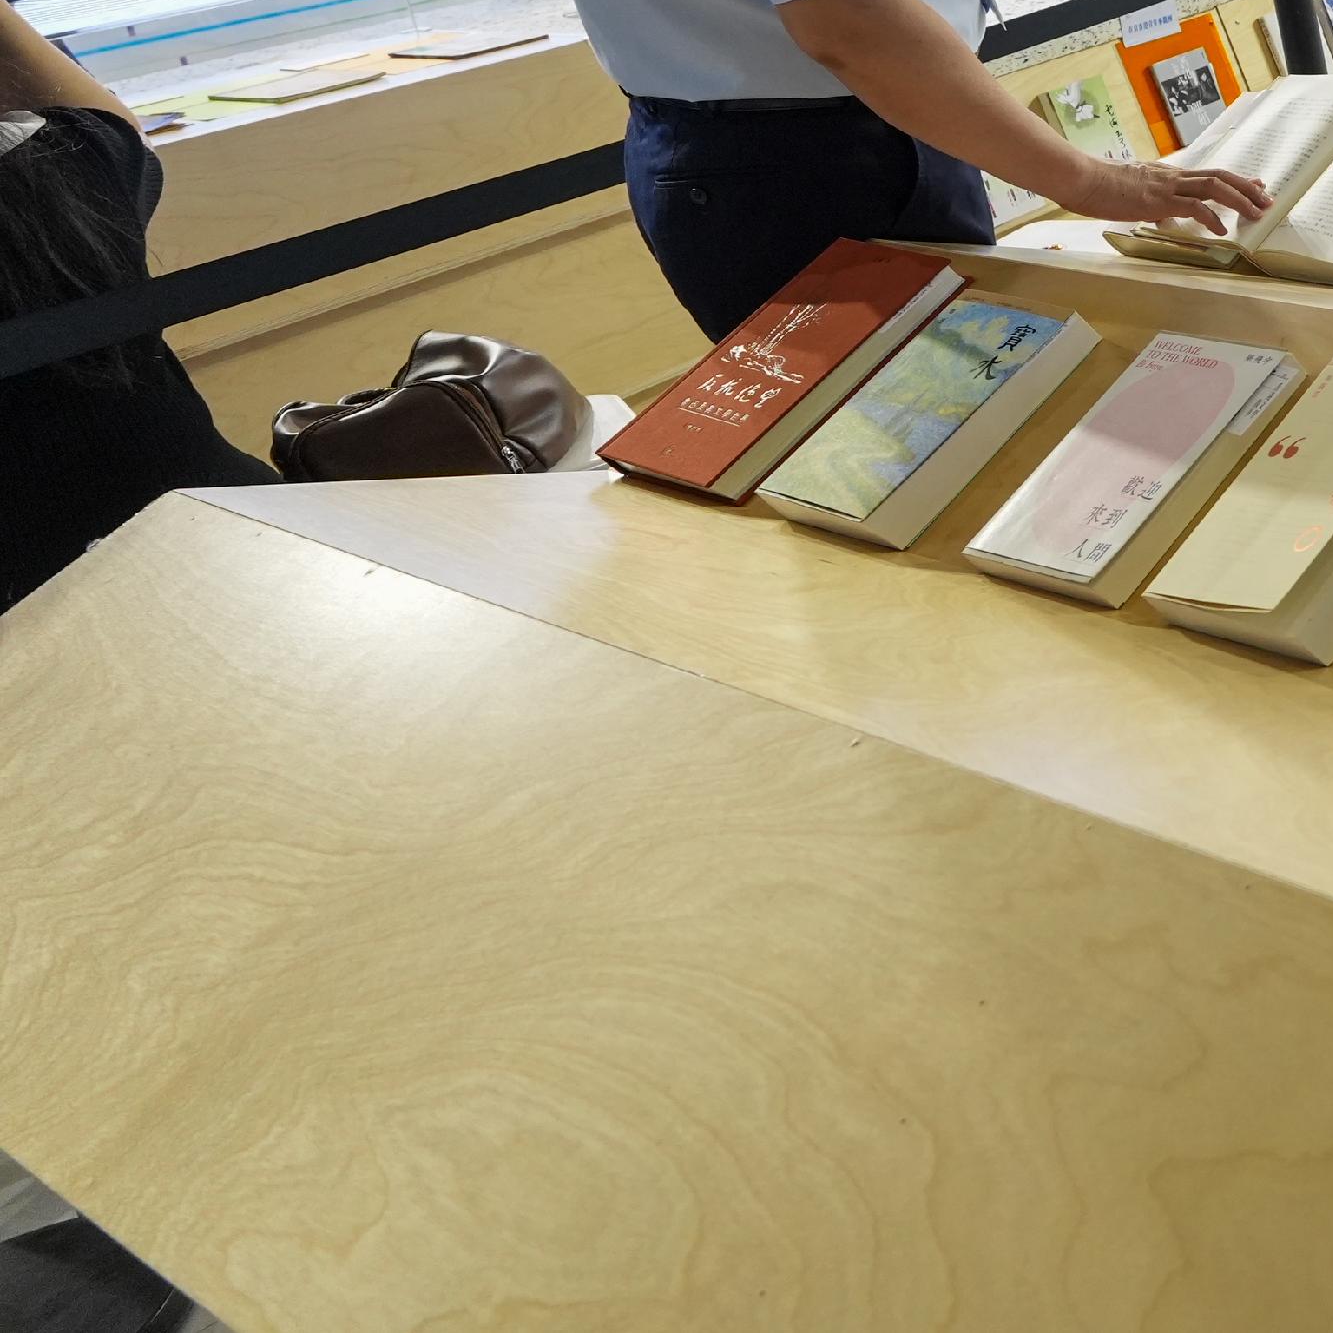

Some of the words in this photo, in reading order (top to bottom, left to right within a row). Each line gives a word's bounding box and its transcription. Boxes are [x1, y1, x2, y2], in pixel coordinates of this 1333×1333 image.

[1155, 340, 1203, 355] WELCOME
[1181, 354, 1219, 370] WORLD
[1121, 474, 1163, 501] 歡迎
[1087, 503, 1129, 529] 來到
[1065, 538, 1113, 563] 人間
